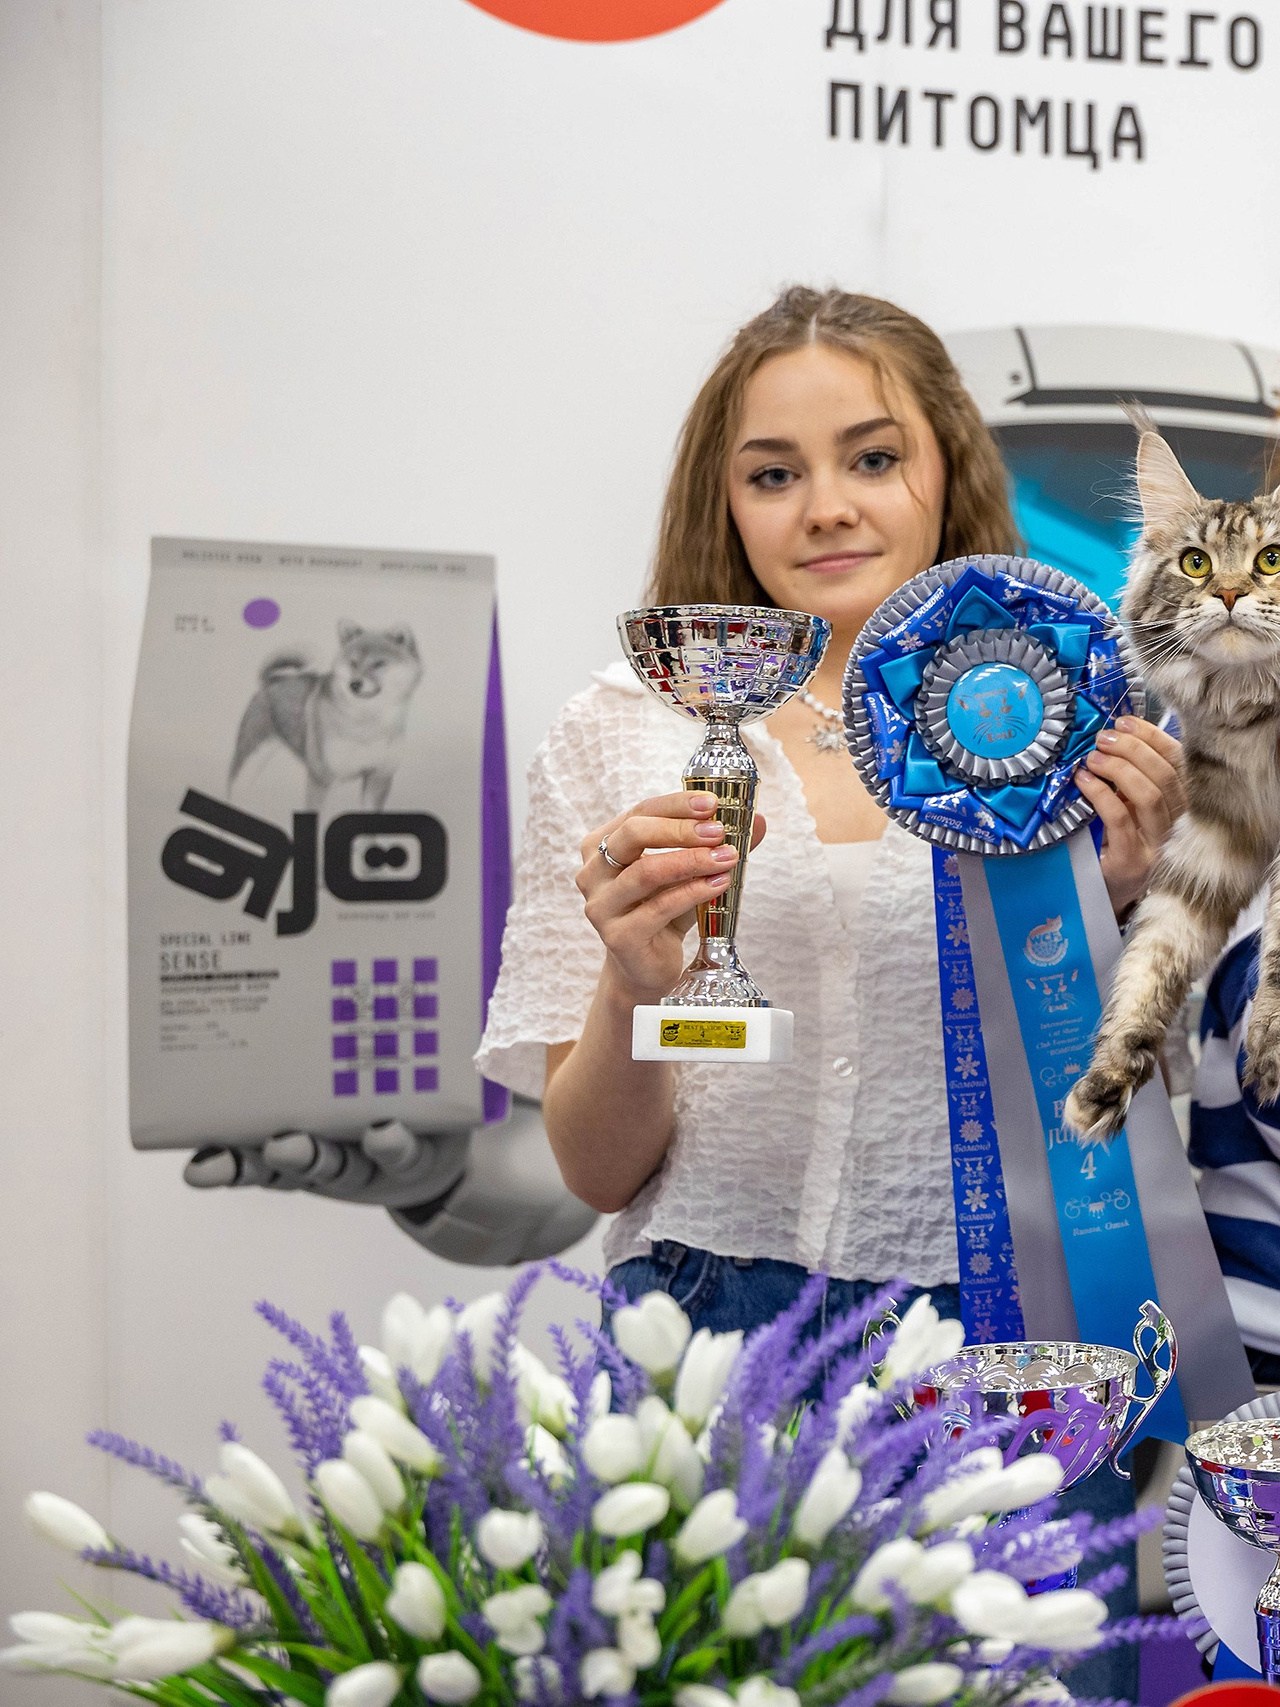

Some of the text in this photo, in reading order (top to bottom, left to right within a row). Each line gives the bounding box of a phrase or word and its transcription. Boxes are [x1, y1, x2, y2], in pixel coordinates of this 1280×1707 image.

[825, 0, 1260, 70] ДЛЯ ВАШЕГО
[829, 81, 1146, 171] ПИТОМЦА
[159, 950, 219, 971] SENSE
[949, 1077, 987, 1090] Бомонд
[953, 1141, 991, 1153] Бомонд
[1080, 1150, 1098, 1180] 4
[958, 1209, 997, 1222] Бомонд
